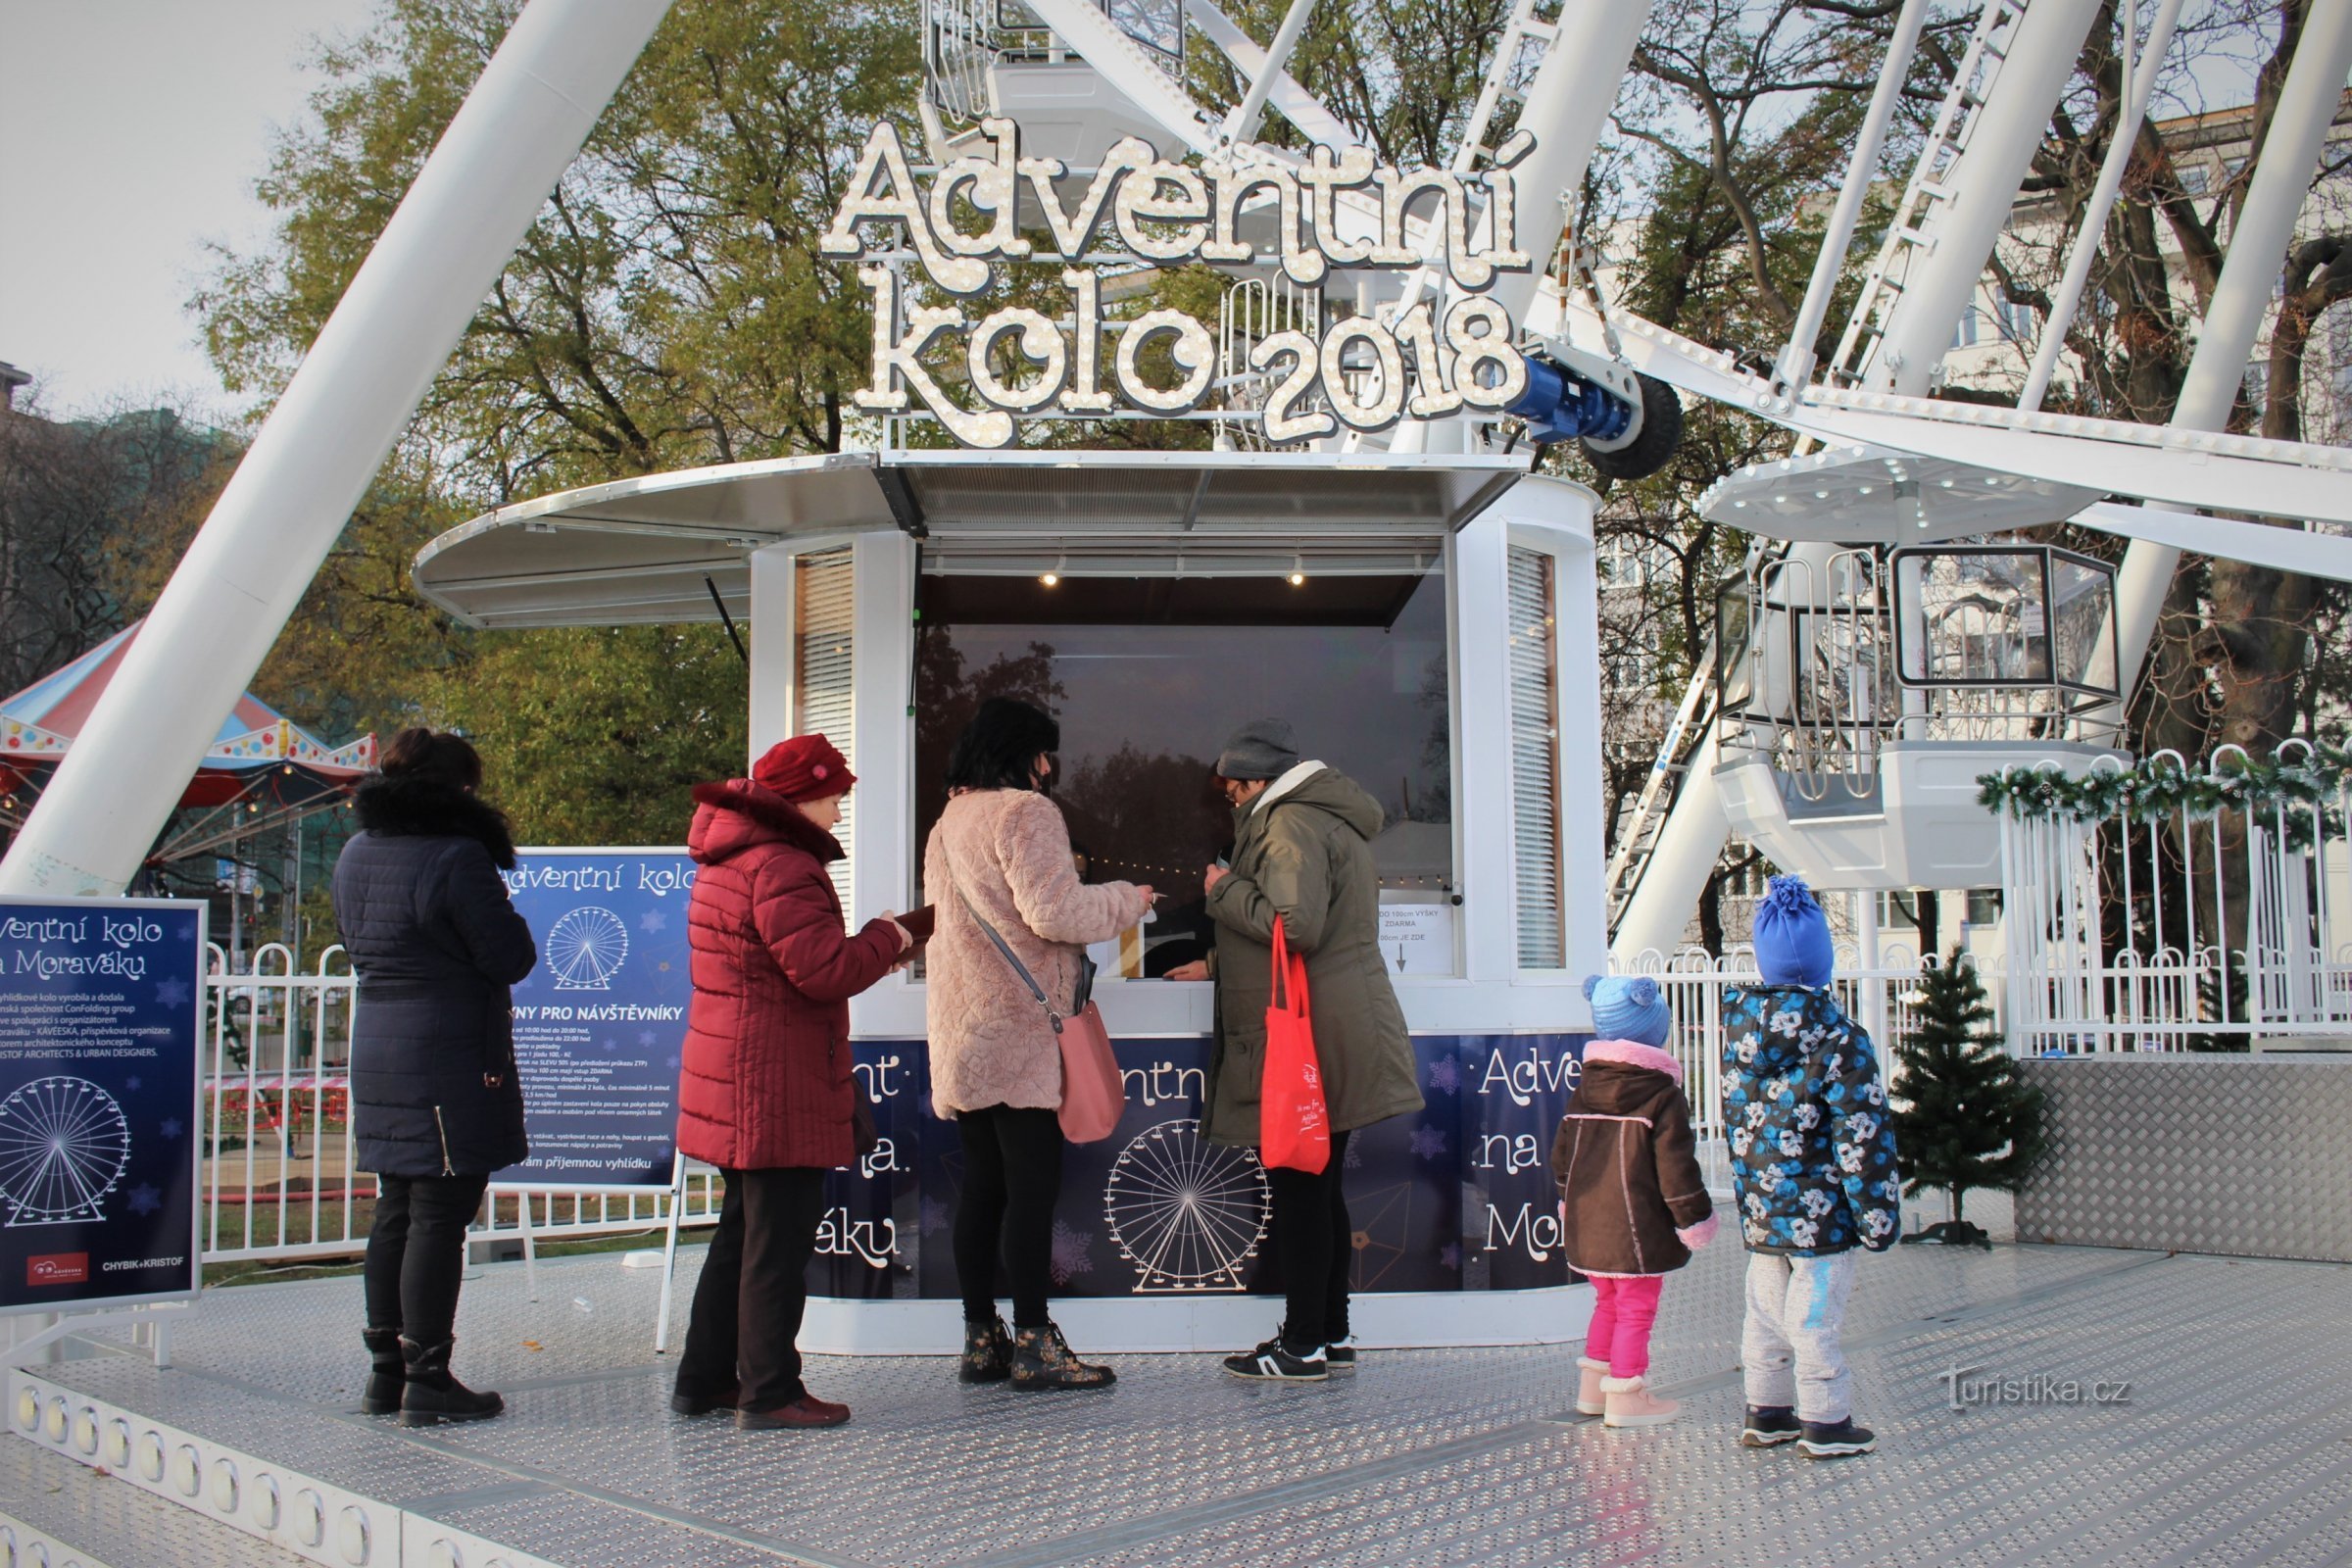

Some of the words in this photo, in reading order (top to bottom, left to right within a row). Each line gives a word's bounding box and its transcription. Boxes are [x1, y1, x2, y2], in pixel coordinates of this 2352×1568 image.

[820, 117, 1536, 293] Adventní
[853, 267, 1218, 449] kolo
[1250, 294, 1530, 447] 2018
[501, 863, 624, 895] Adventní
[102, 916, 162, 948] kolo
[15, 950, 146, 980] Moraváku
[21, 1004, 64, 1014] společnost
[111, 1005, 135, 1014] group
[39, 993, 57, 1002] kolo
[58, 993, 90, 1003] vyrobila
[97, 993, 124, 1002] dodala
[541, 1006, 572, 1020] PRO
[577, 1004, 683, 1021] NÁVŠTĚVNÍKY
[24, 1049, 74, 1059] ARCHITECTS
[83, 1049, 111, 1057] URBAN
[545, 1156, 603, 1170] příjemnou
[606, 1157, 652, 1171] vyhlídku
[1480, 1134, 1542, 1175] na
